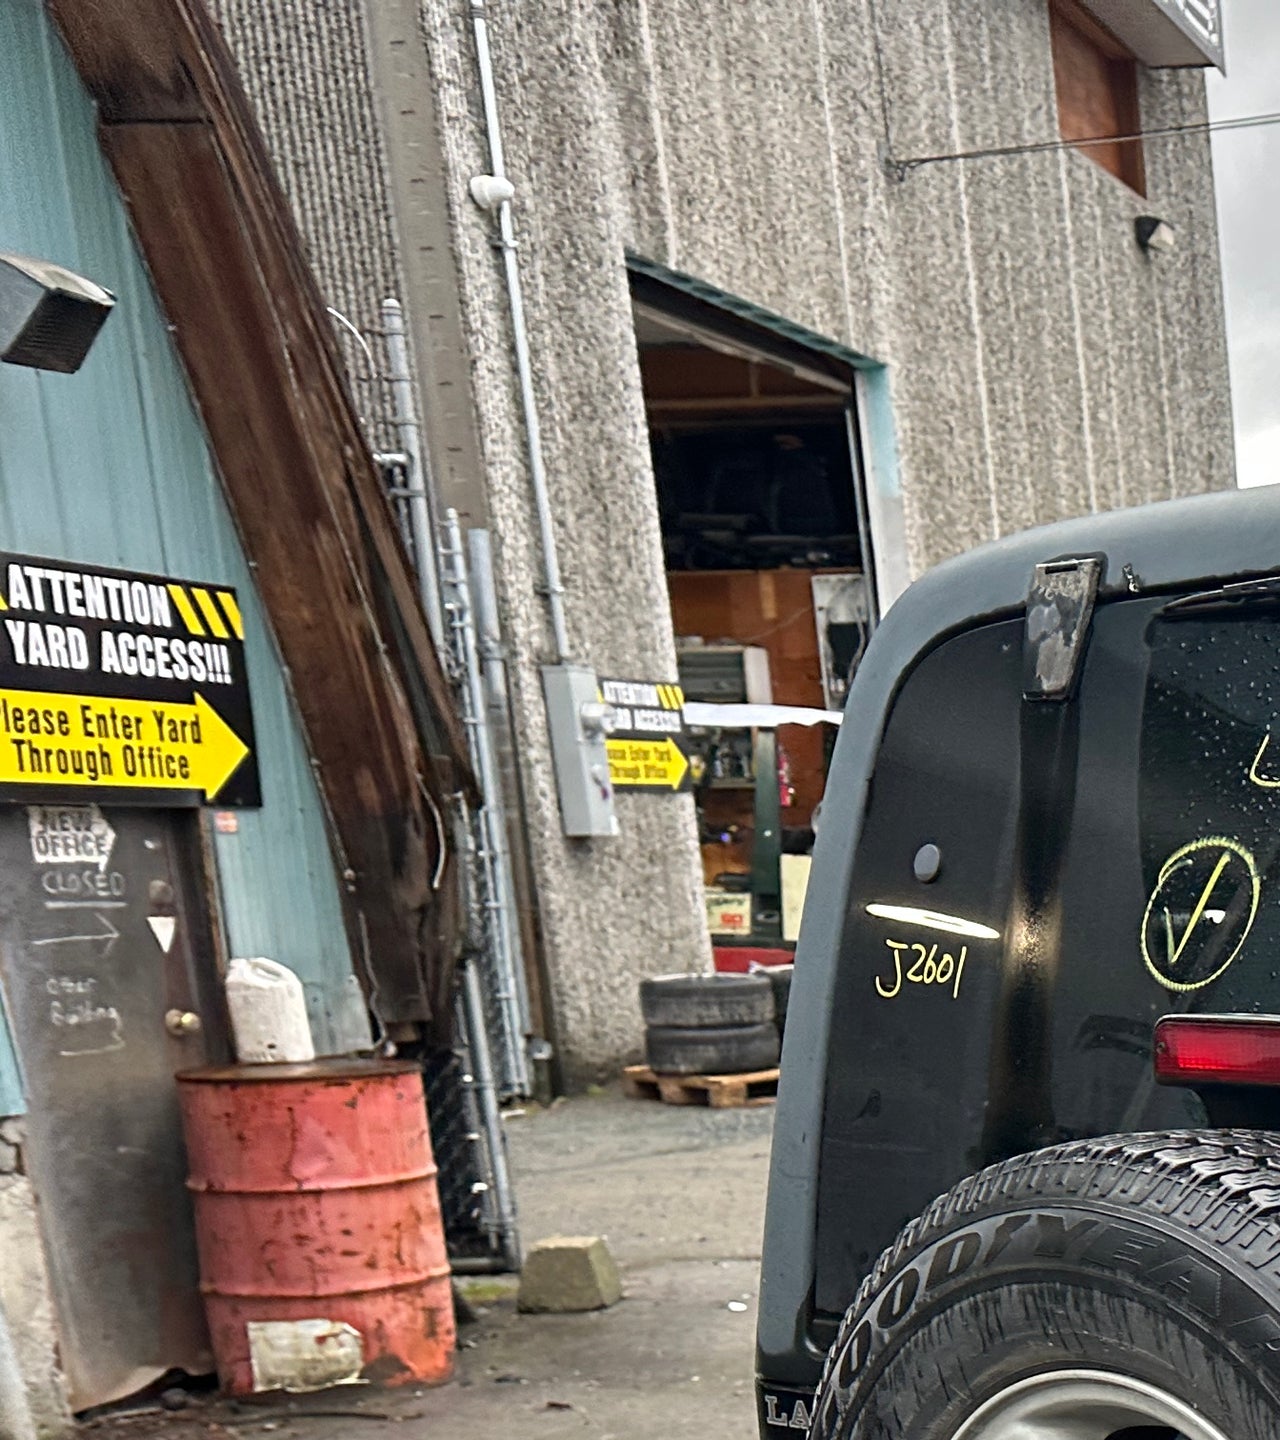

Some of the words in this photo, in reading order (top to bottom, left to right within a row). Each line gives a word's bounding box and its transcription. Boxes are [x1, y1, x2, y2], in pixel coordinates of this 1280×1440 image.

[8, 563, 172, 628] ATTENTION
[5, 619, 89, 670] YARD
[101, 630, 232, 685] ACCESS!!!
[0, 698, 70, 736] lease
[81, 704, 143, 741] Enter
[153, 710, 202, 744] Yard
[11, 738, 113, 781] Through
[123, 744, 190, 780] Office
[41, 870, 126, 897] CLOSED
[875, 939, 968, 999] J2601
